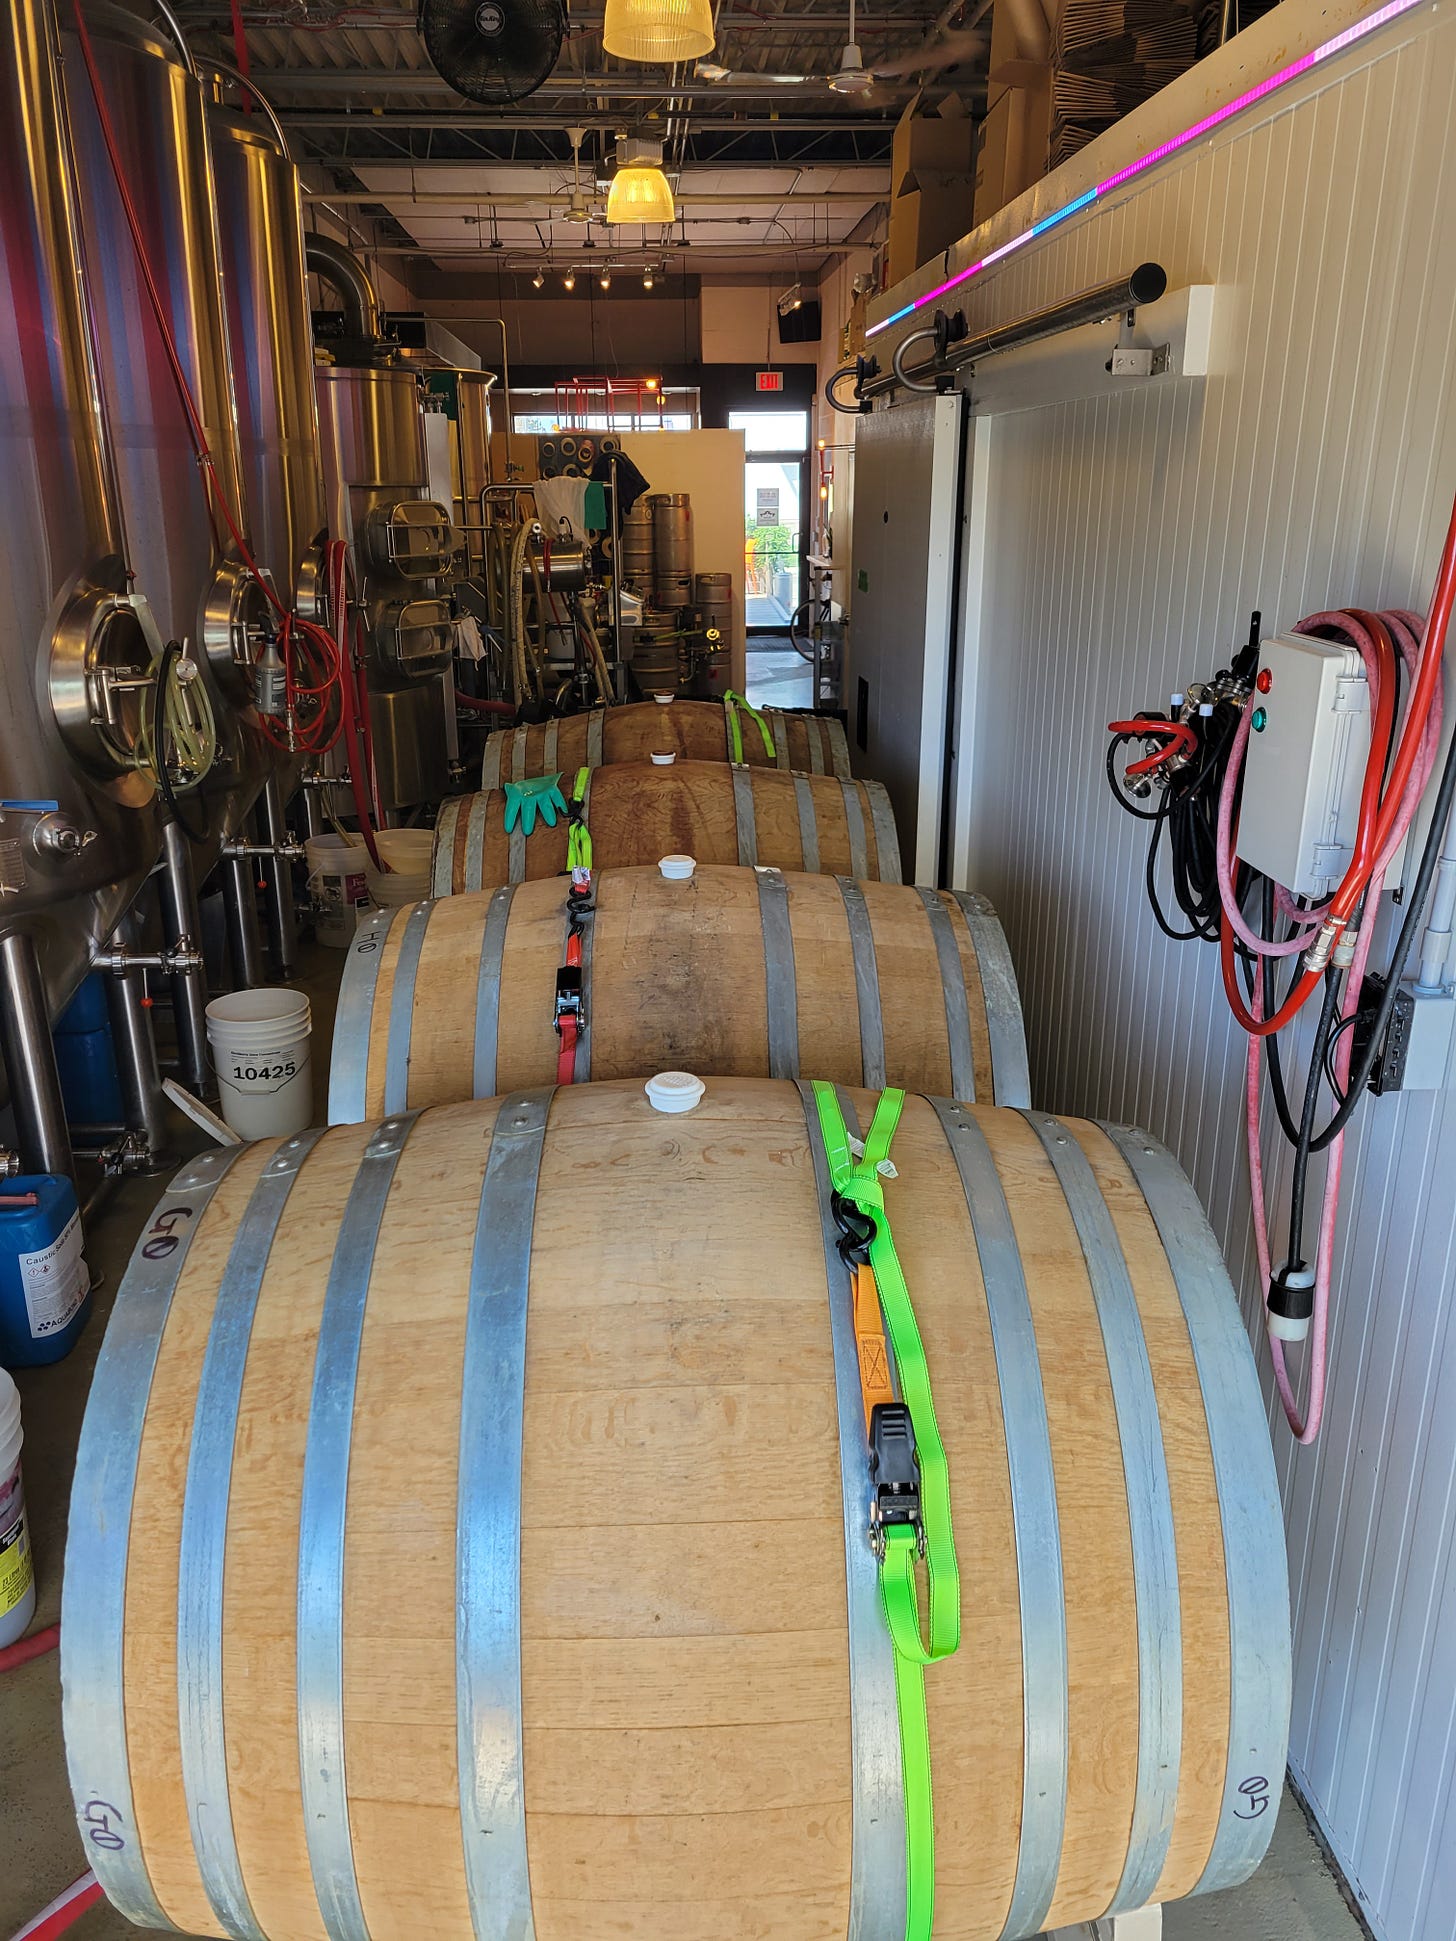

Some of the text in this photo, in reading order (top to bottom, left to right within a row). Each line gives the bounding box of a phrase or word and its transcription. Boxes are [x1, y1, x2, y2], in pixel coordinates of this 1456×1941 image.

[760, 373, 778, 390] EXIT
[233, 1061, 296, 1081] 10425
[26, 1248, 56, 1266] Caustic
